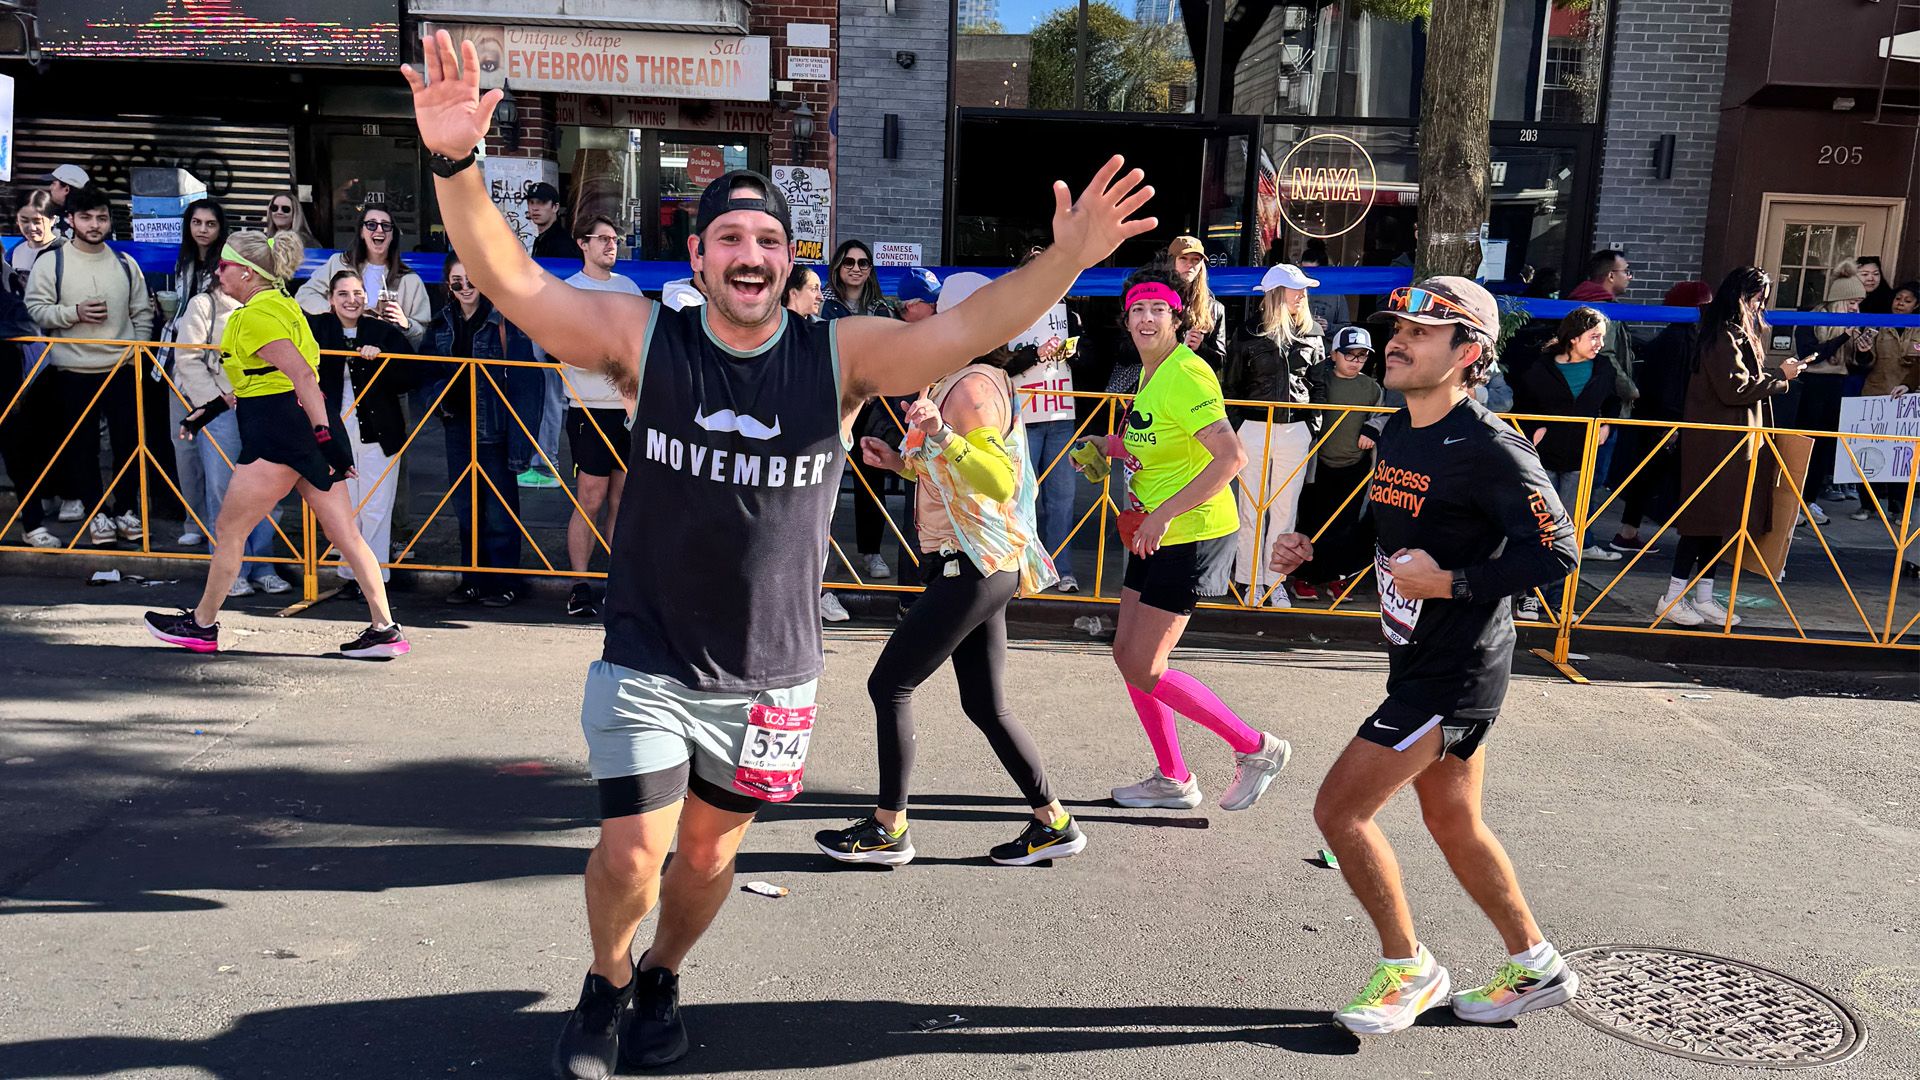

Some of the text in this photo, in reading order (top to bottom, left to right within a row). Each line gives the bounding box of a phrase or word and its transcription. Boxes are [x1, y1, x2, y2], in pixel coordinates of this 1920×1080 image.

[507, 27, 568, 50] Unique
[571, 28, 622, 54] Shape
[508, 50, 753, 88] EYEBROWS THREADIN
[628, 109, 666, 126] TINTING
[1519, 128, 1538, 142] 203
[701, 150, 711, 158] No
[1818, 145, 1863, 165] 205
[691, 158, 721, 168] Double Dip
[701, 167, 710, 175] For
[695, 175, 715, 183] Waxin
[1291, 167, 1361, 201] NAYA
[368, 191, 385, 204] 201
[135, 222, 181, 232] NO PARKING
[882, 244, 913, 253] SIAMESE
[875, 252, 919, 261] CONNECTION
[1020, 378, 1073, 413] THE
[1374, 458, 1432, 493] Success
[1369, 484, 1426, 518] cademy
[764, 708, 786, 726] tcs
